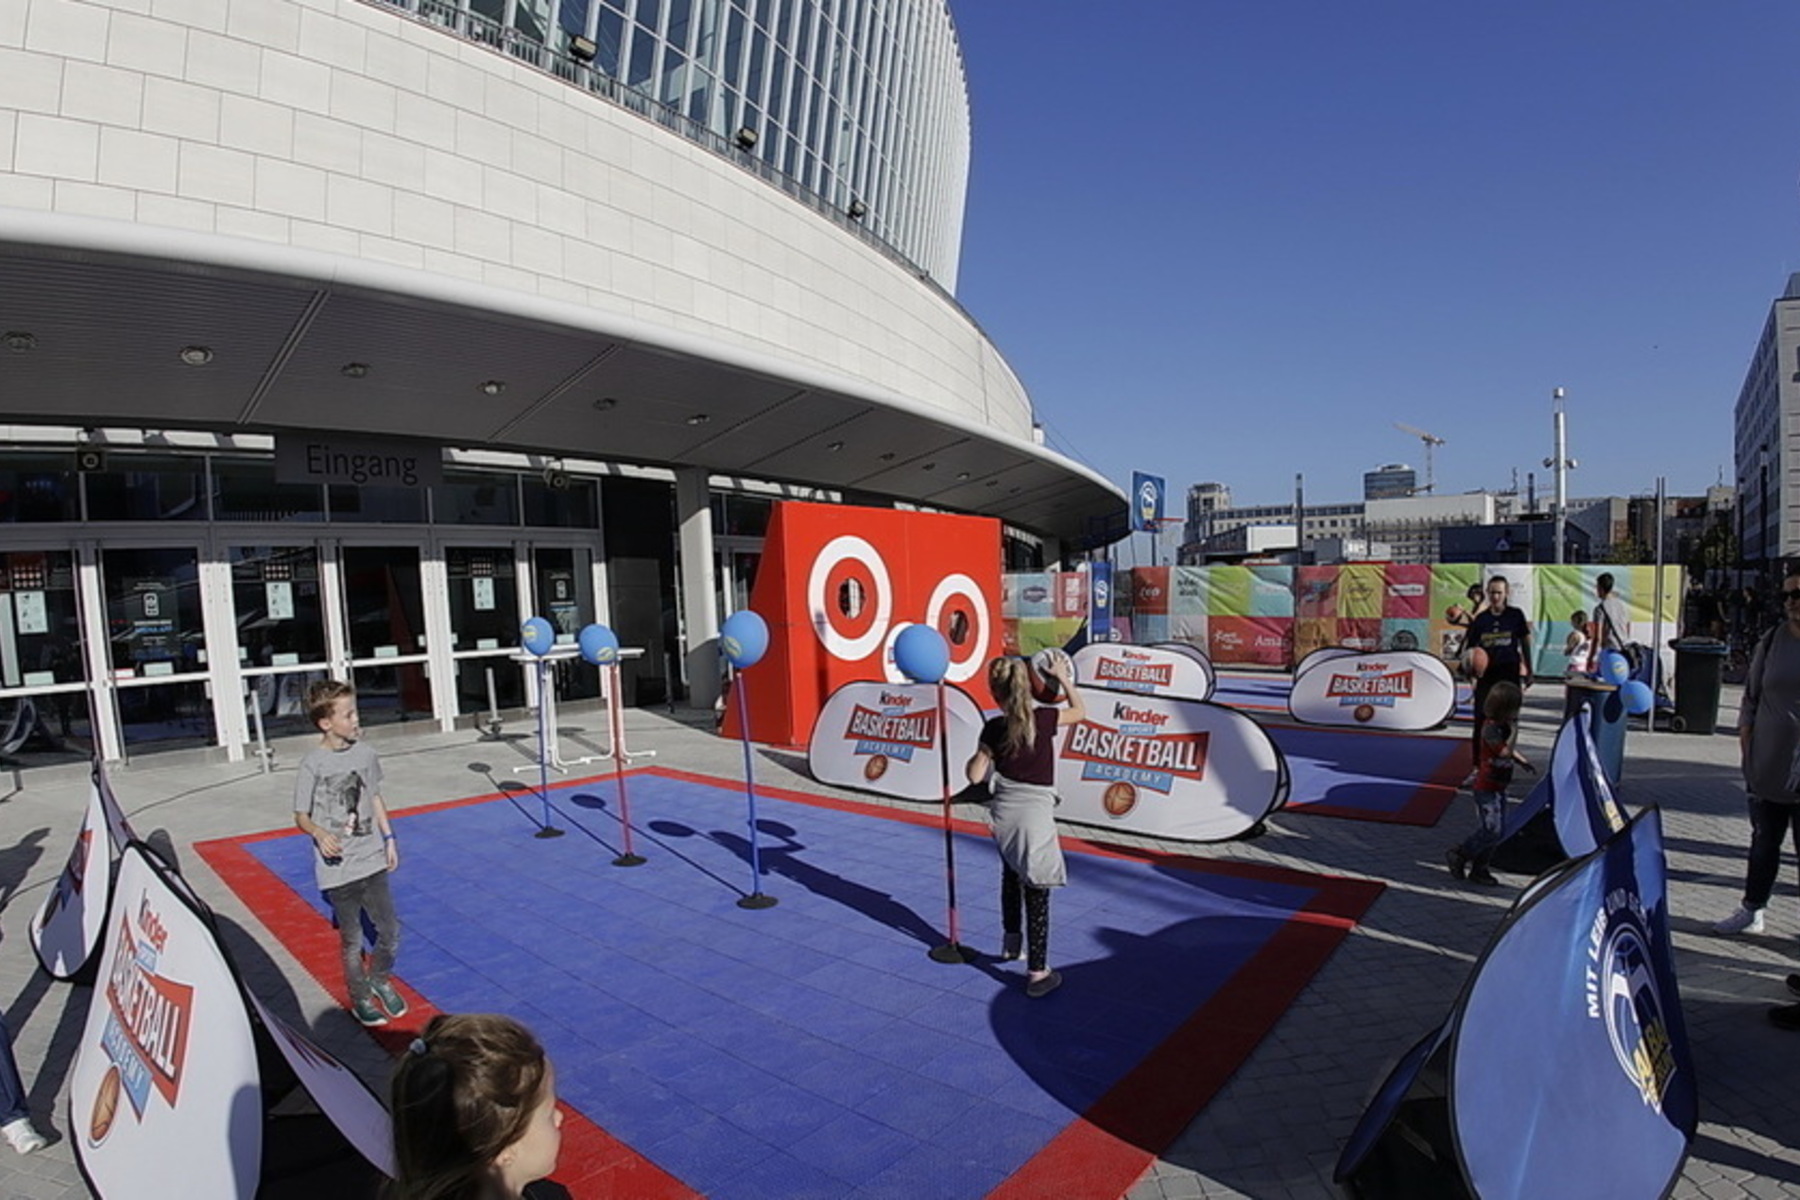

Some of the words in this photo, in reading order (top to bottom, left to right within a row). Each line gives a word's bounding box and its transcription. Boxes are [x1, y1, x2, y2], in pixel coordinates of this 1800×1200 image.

[306, 444, 418, 486] Eingang
[1100, 660, 1168, 683] BASKETBALL
[1331, 675, 1409, 694] BASKETBALL
[850, 710, 931, 741] BASKETBALL
[863, 741, 907, 755] ACADEMY
[1070, 723, 1198, 771] BASKETBALL
[1095, 764, 1163, 784] ACADEMY
[112, 926, 180, 1079] BASKETBALL
[1586, 964, 1601, 1018] MIT
